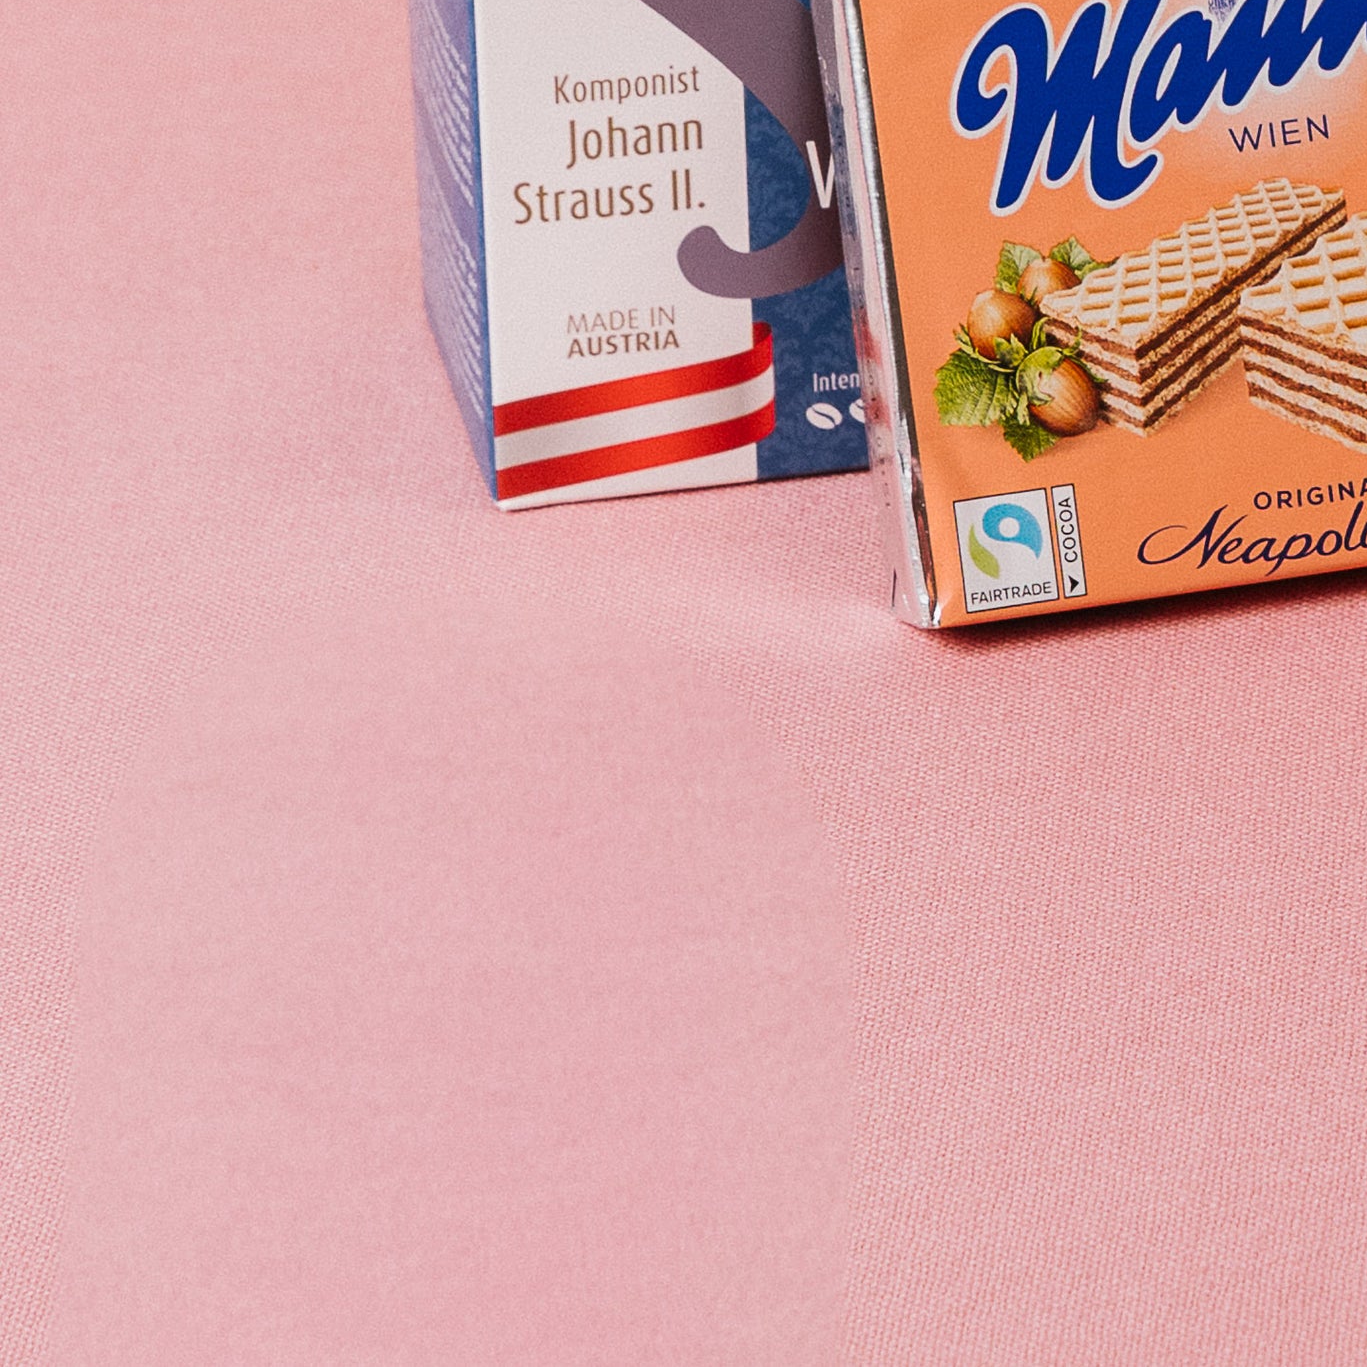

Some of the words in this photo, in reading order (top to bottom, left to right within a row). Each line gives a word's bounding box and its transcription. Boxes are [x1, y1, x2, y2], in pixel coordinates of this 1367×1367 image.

[553, 67, 701, 106] Komponist
[566, 117, 705, 171] Johann
[1229, 113, 1332, 156] WIEN
[512, 175, 654, 226] Strauss
[671, 170, 707, 210] II.
[566, 310, 641, 336] MADE
[649, 305, 676, 330] IN
[567, 328, 681, 360] AUSTRIA
[812, 370, 861, 394] Inten
[1063, 495, 1078, 567] COCOA
[969, 579, 1054, 607] FAIRTRADE
